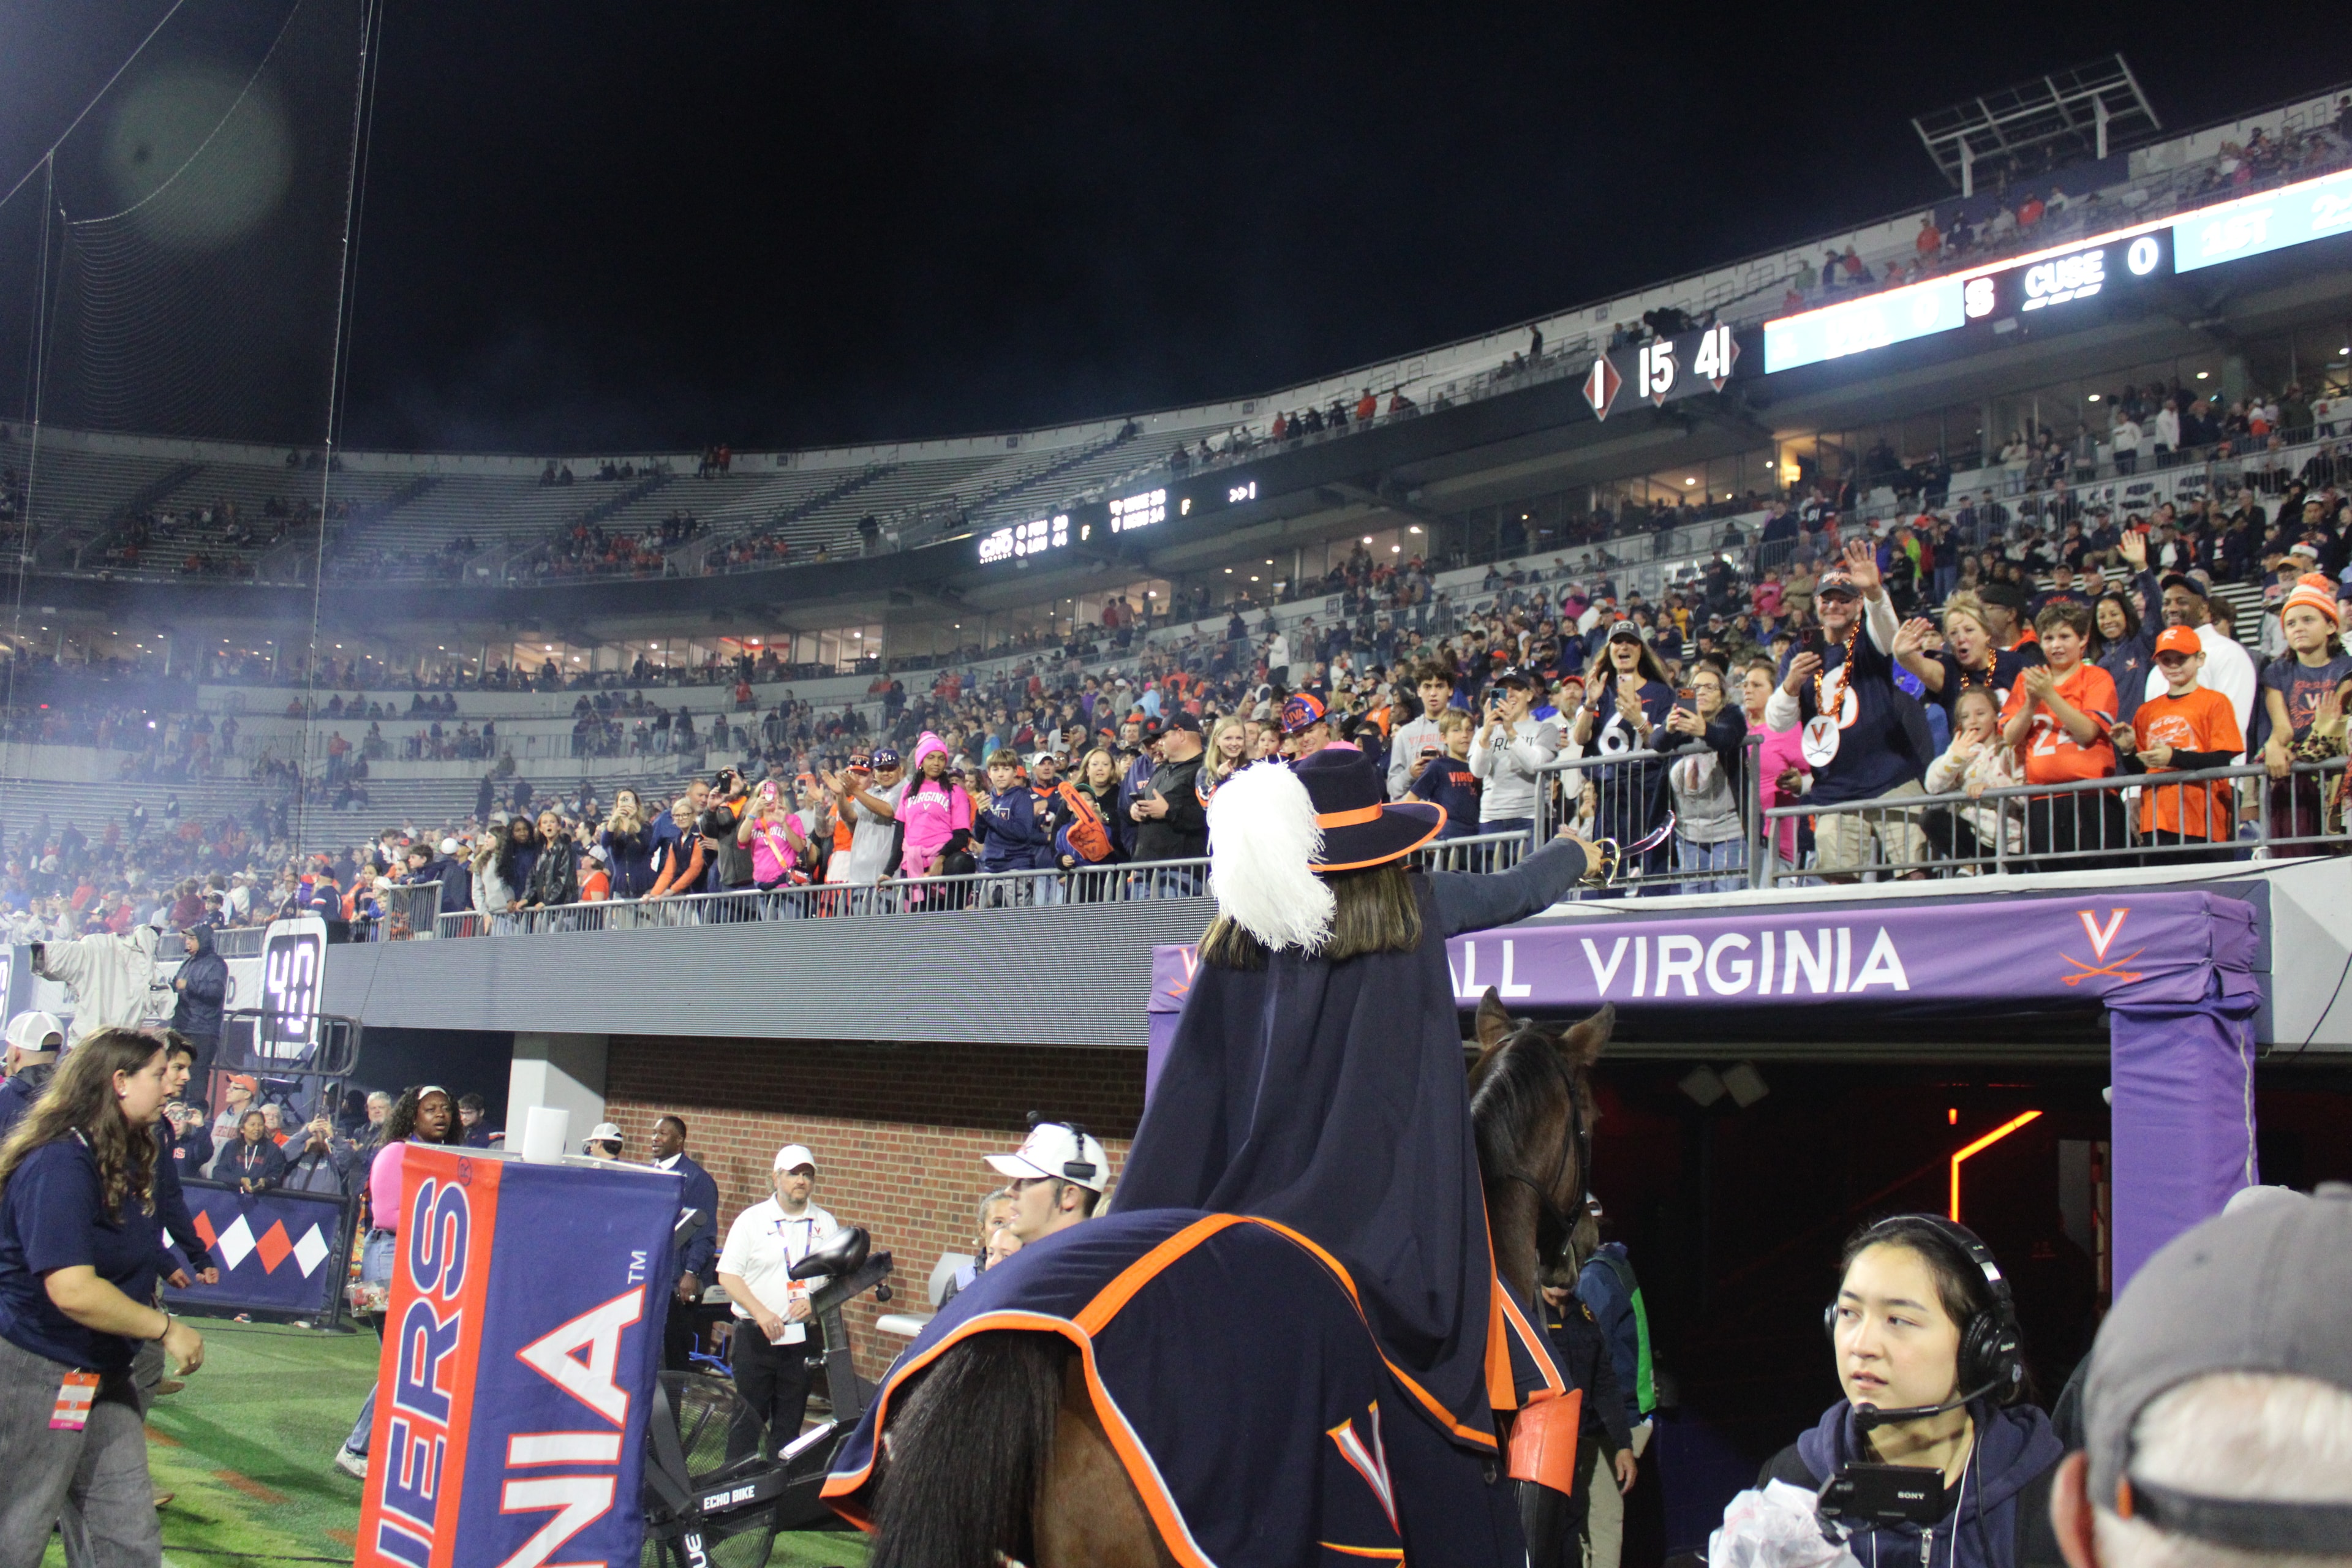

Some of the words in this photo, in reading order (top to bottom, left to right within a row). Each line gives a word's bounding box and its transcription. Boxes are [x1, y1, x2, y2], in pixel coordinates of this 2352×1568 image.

[2201, 209, 2273, 257] 1ST
[2024, 250, 2105, 298] CUSE
[2128, 237, 2159, 276] 0
[1594, 360, 1604, 409] 1
[1640, 341, 1674, 398] 15
[1694, 326, 1730, 380] 41
[1052, 531, 1067, 547] 44
[907, 791, 951, 812] VIRGINIA
[1581, 925, 1911, 998] VIRGINIA
[704, 1492, 730, 1510] ECHO
[732, 1485, 755, 1502] BIKE
[1898, 1490, 1925, 1500] SONY
